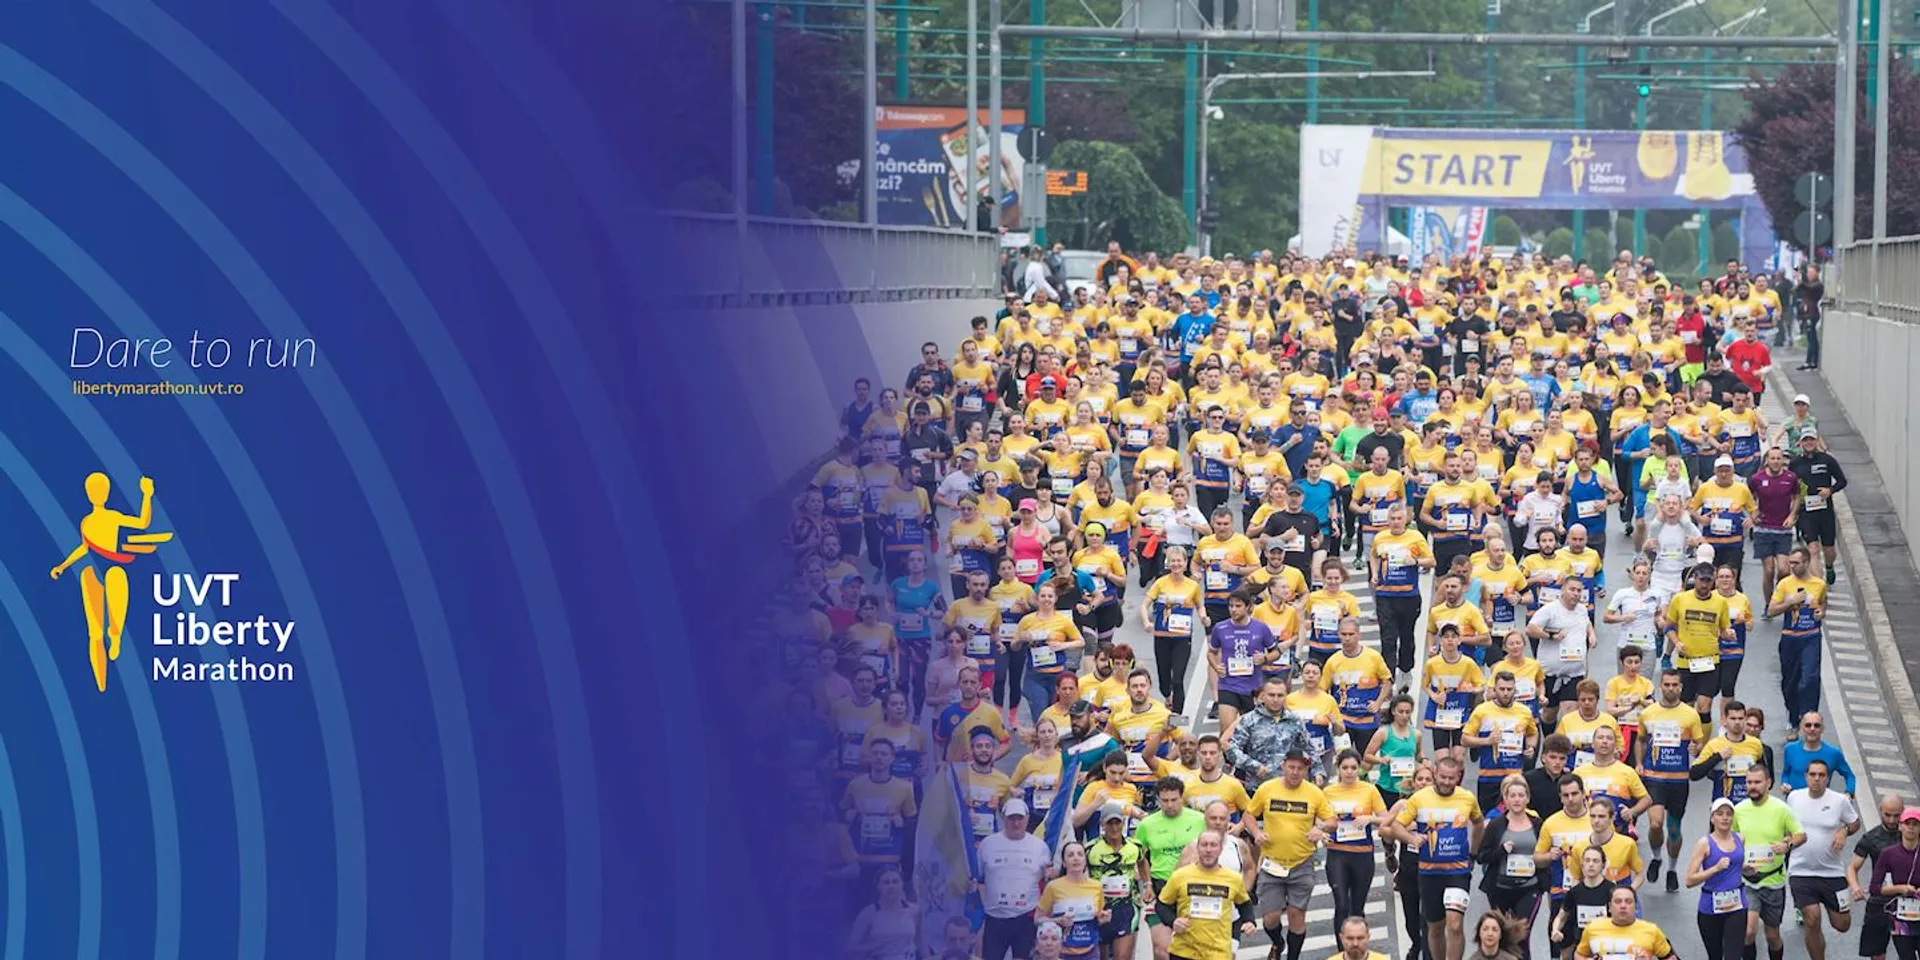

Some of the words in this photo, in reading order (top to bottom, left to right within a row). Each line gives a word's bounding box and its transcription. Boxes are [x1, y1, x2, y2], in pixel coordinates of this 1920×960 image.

[1394, 153, 1522, 186] START
[1589, 163, 1613, 173] UVT
[876, 175, 902, 190] zi?
[1589, 174, 1627, 185] Liberty
